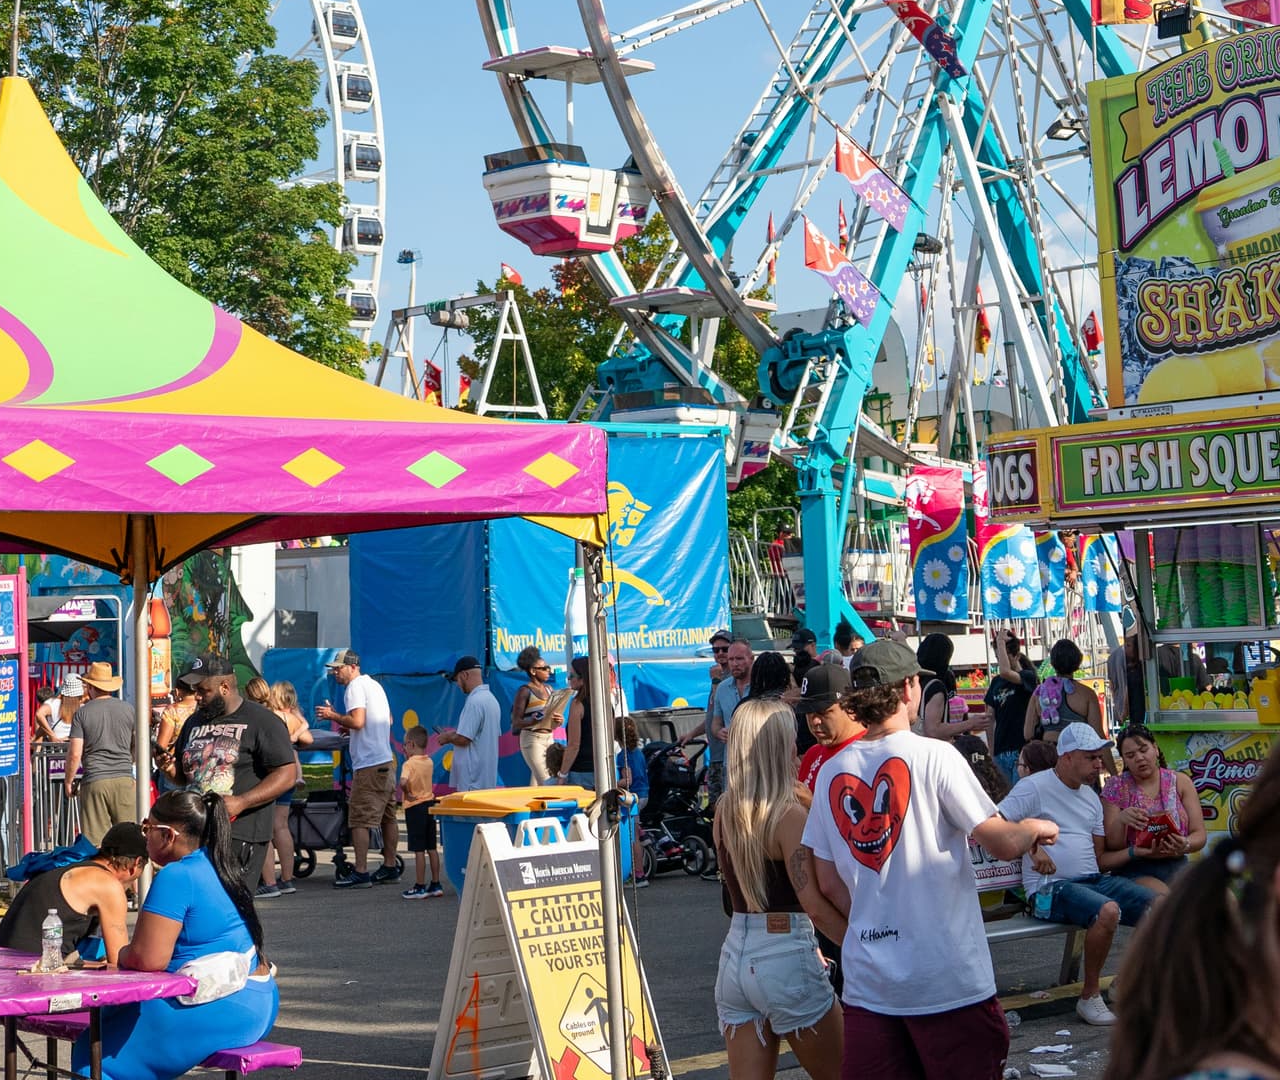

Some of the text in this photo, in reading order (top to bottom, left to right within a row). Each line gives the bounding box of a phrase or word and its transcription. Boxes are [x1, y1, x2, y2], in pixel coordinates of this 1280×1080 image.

[1146, 51, 1214, 128] THE
[1217, 198, 1269, 229] Grandma
[762, 398, 772, 409] 6
[1081, 439, 1184, 497] FRESH
[800, 677, 809, 695] B
[189, 723, 248, 741] DIPSET
[530, 901, 603, 925] CAUTION
[528, 934, 605, 958] PLEASE WAT
[546, 952, 607, 972] YOUR STE
[565, 1020, 587, 1031] Cables
[571, 1028, 595, 1040] ground
